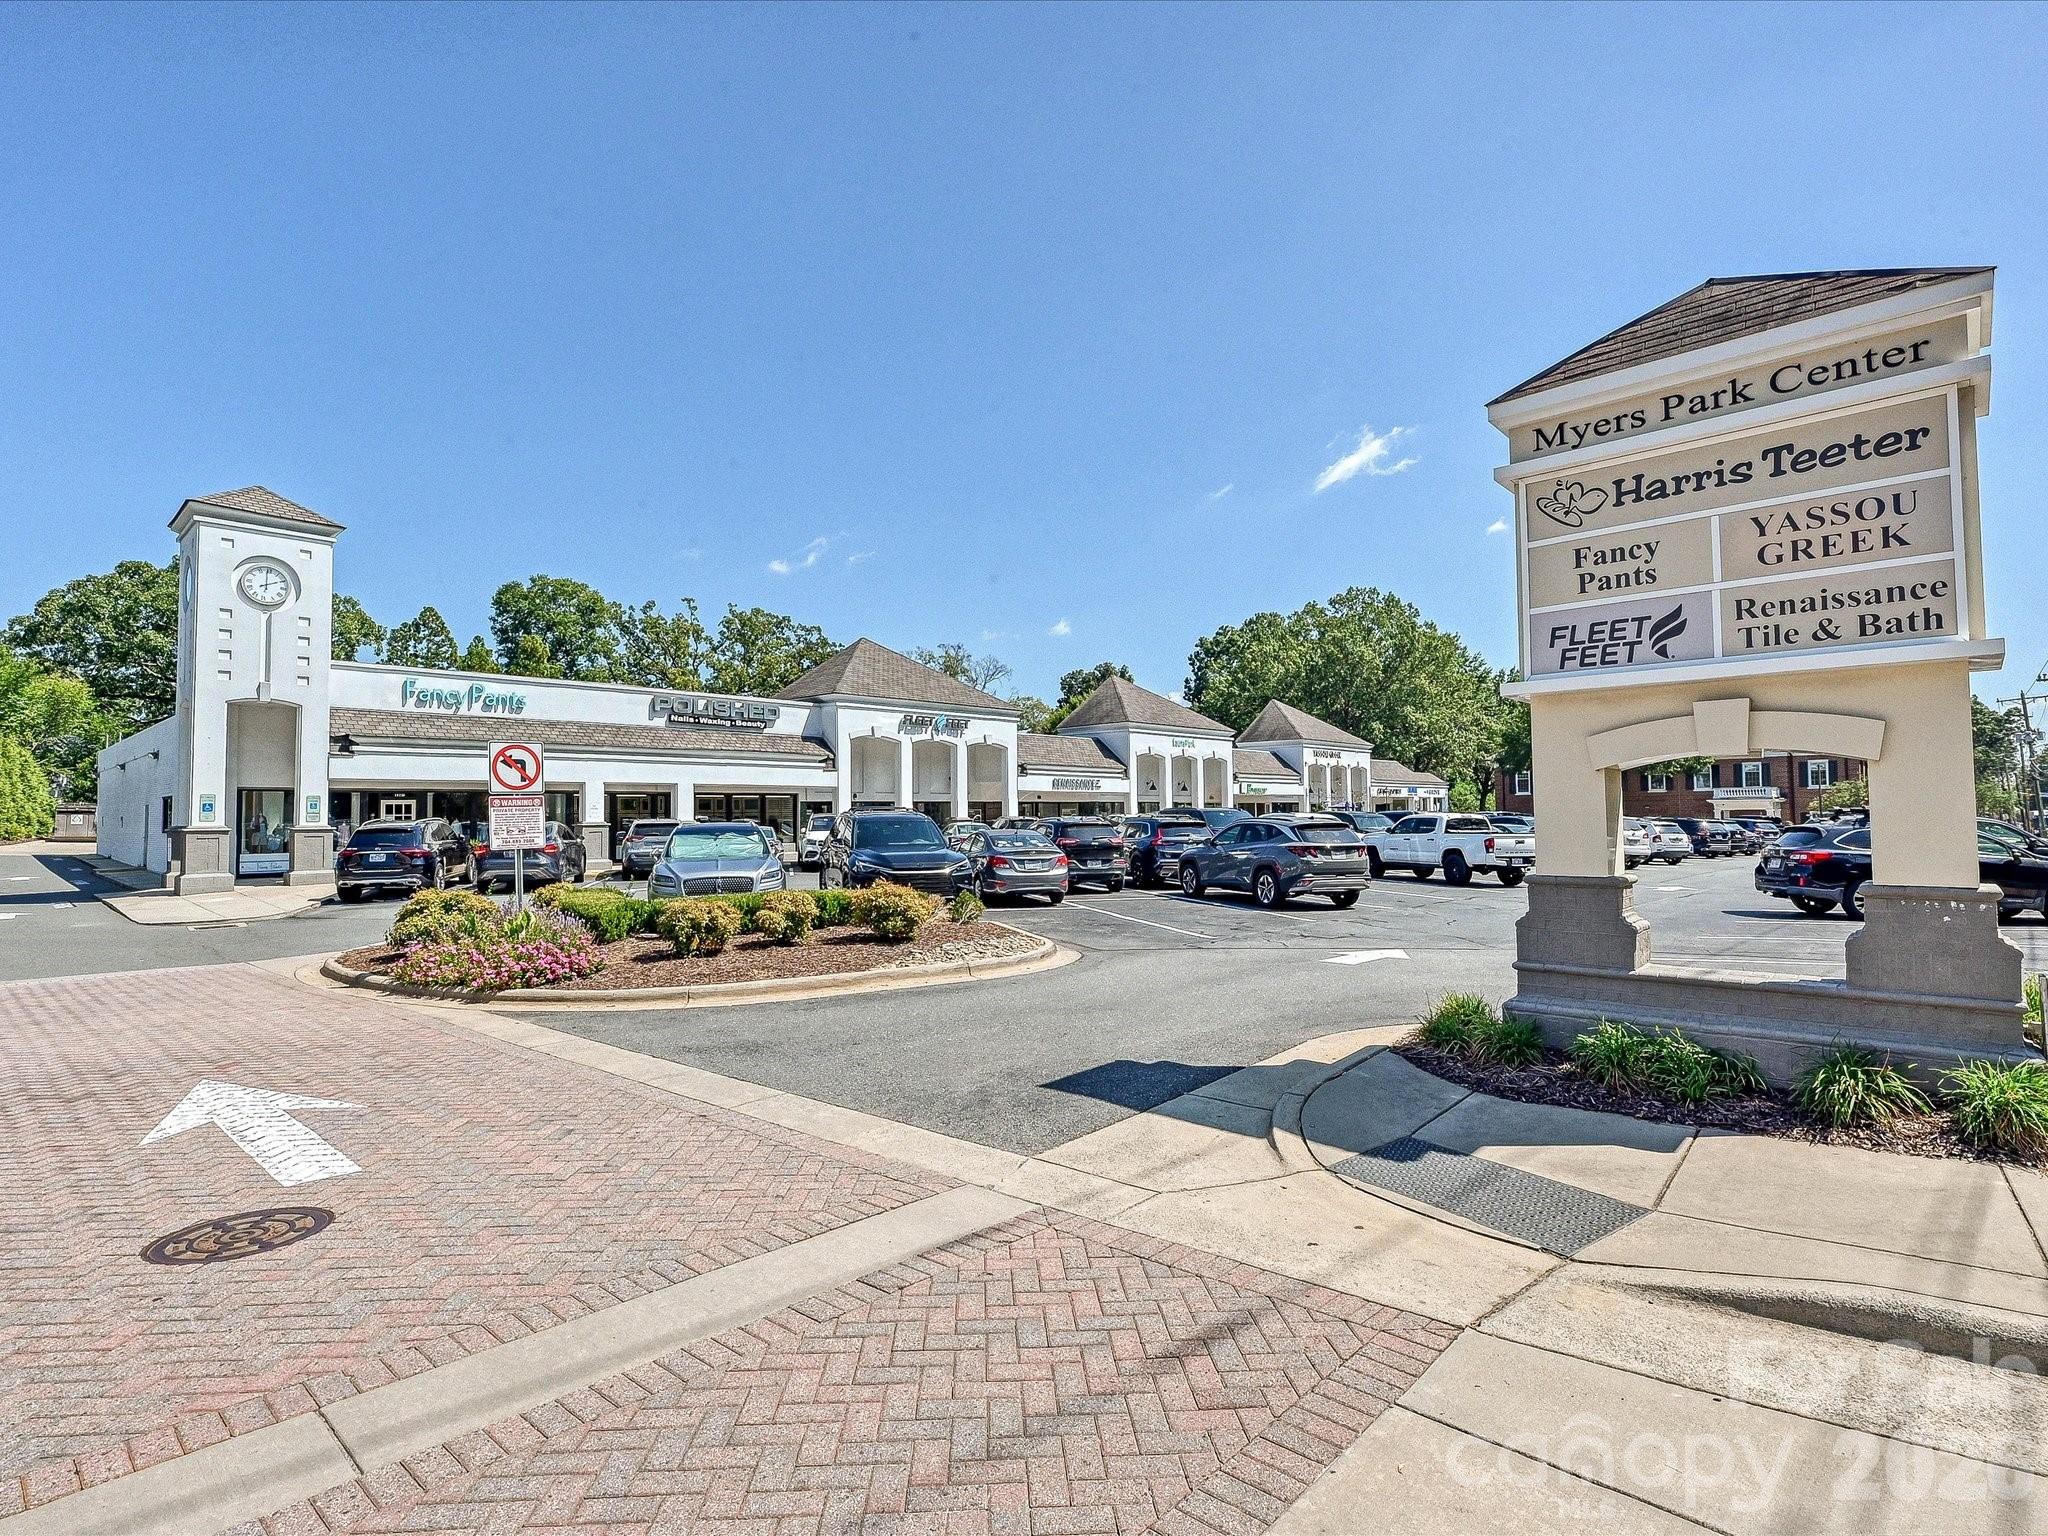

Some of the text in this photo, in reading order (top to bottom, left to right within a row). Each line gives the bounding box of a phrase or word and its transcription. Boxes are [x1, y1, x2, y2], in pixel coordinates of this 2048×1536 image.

[1531, 337, 1931, 453] Myers Park Center
[1611, 424, 1931, 509] Harris Teeter
[1749, 489, 1918, 538] YASSOU
[1572, 538, 1661, 570] Fancy
[1757, 522, 1912, 566] GREEK
[1577, 564, 1658, 595] Pants
[1734, 578, 1950, 622] Renaissance
[1548, 615, 1652, 650] FLEET
[1737, 607, 1945, 649] Tile & Bath
[1558, 640, 1643, 670] FEET
[404, 677, 527, 710] Fancy Pants
[652, 693, 781, 720] POLISHED
[669, 714, 767, 729] Nails Waxing Beauty
[501, 799, 533, 807] WARNING
